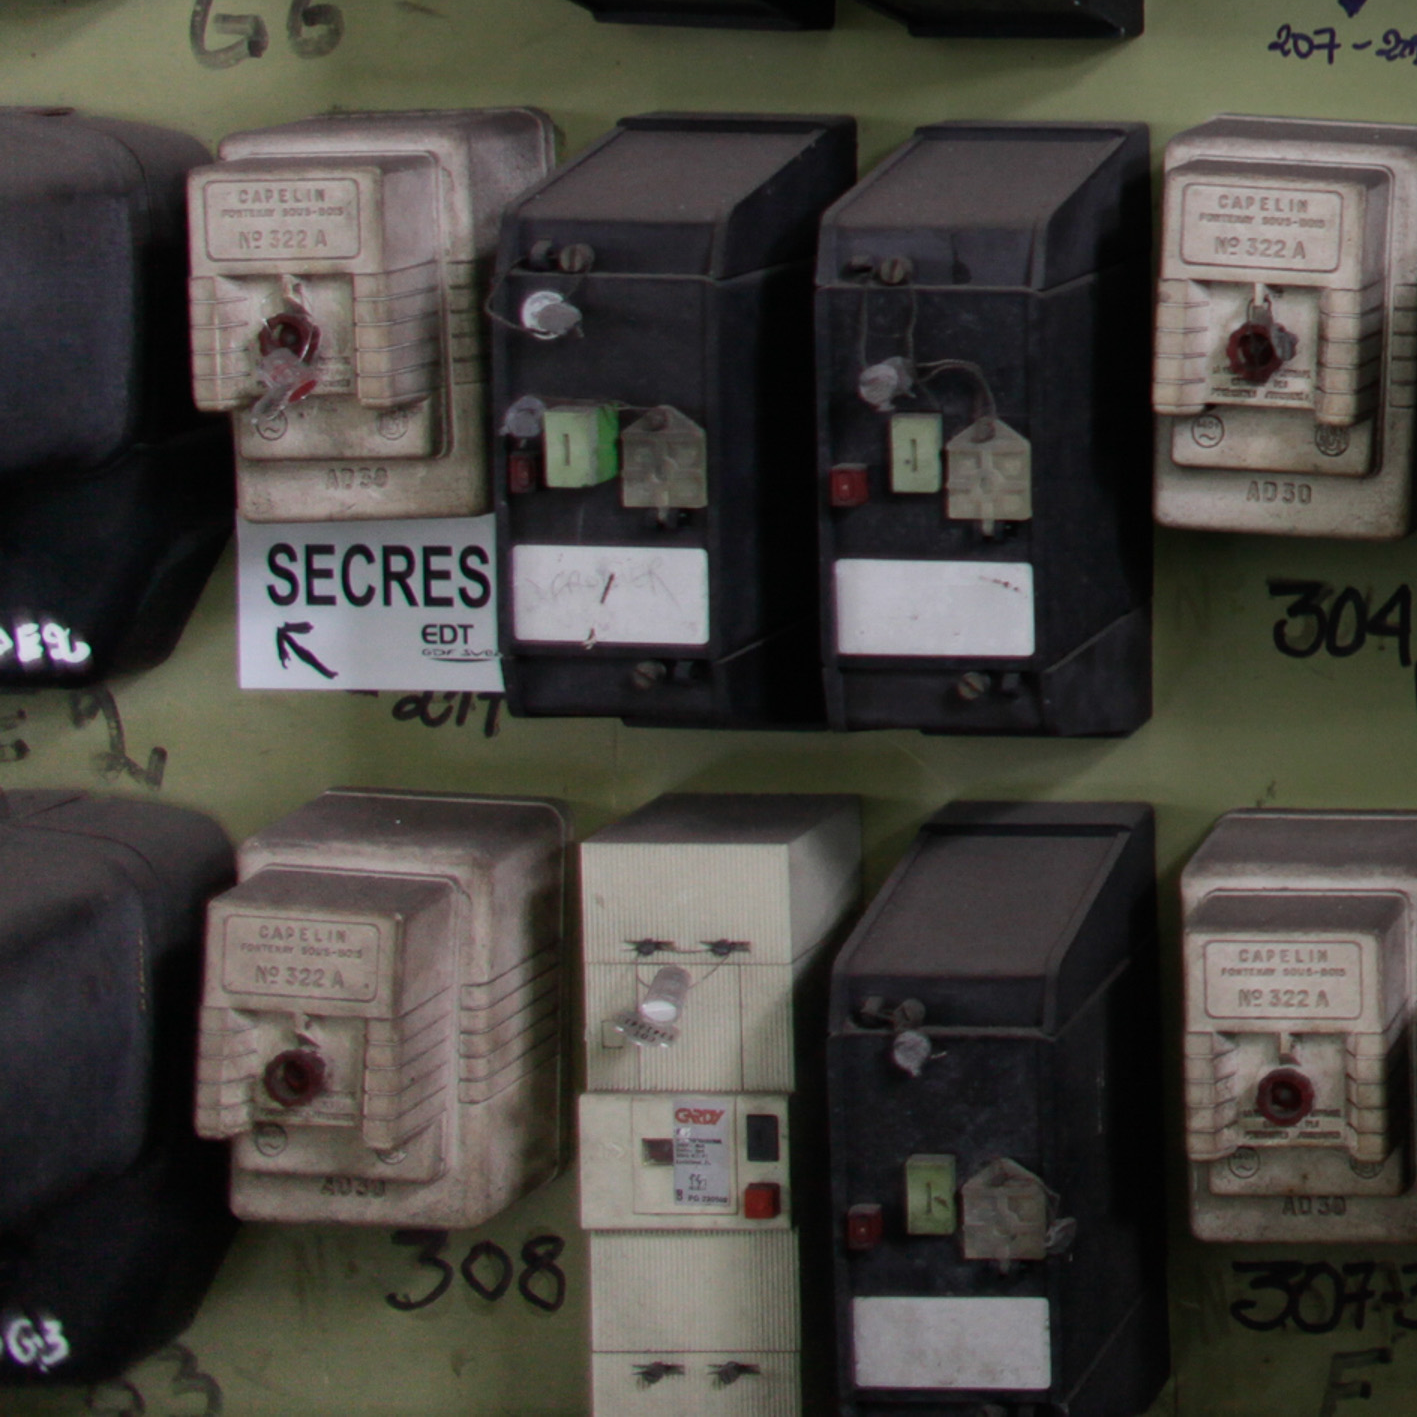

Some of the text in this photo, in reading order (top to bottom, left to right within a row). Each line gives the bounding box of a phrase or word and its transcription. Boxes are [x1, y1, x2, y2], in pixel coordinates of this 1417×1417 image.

[238, 187, 327, 204] CAPELIN
[1216, 193, 1310, 214] CAPELIN
[268, 230, 309, 250] 322
[1246, 237, 1287, 259] 322
[266, 541, 491, 610] SECRES
[1267, 577, 1412, 667] 304
[420, 623, 474, 645] EDT
[1238, 948, 1329, 964] CAPELIN
[1270, 989, 1312, 1009] 322
[388, 1230, 567, 1313] 308
